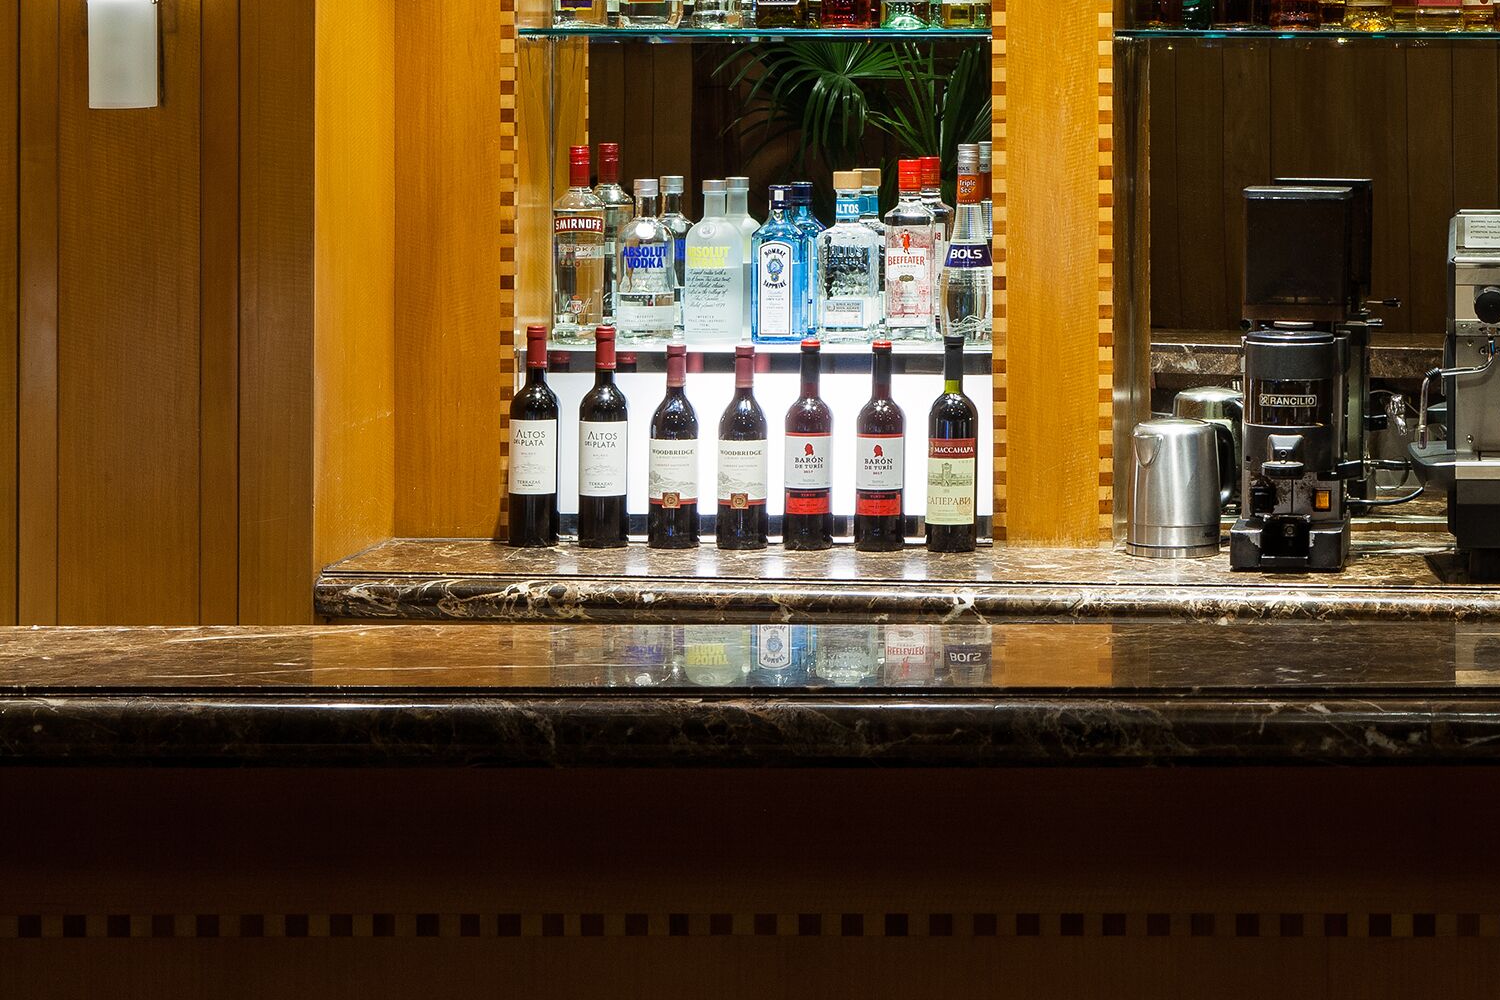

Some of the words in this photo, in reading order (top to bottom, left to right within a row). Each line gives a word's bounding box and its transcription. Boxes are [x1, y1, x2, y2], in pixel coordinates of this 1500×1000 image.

[959, 179, 976, 187] Triple
[960, 186, 972, 194] Sec
[836, 203, 859, 214] ALTOS
[555, 217, 601, 231] SMIRNOFF
[623, 246, 667, 258] ABSOLUT
[764, 247, 787, 258] BOMBAY
[950, 248, 983, 260] BOLS
[627, 257, 663, 269] VODKA
[887, 255, 925, 267] BEEFEATER
[763, 280, 788, 290] SAPPHIRE
[1270, 397, 1315, 406] RANCILIO
[515, 428, 546, 439] ALTOS
[587, 430, 618, 441] ALTOS
[521, 439, 545, 447] PLATA
[592, 441, 616, 449] PLATA
[934, 446, 974, 454] МАССАНДРА
[794, 455, 823, 464] BARÓN
[864, 457, 893, 465] BARÓN
[928, 496, 971, 506] САПЕРАВИ
